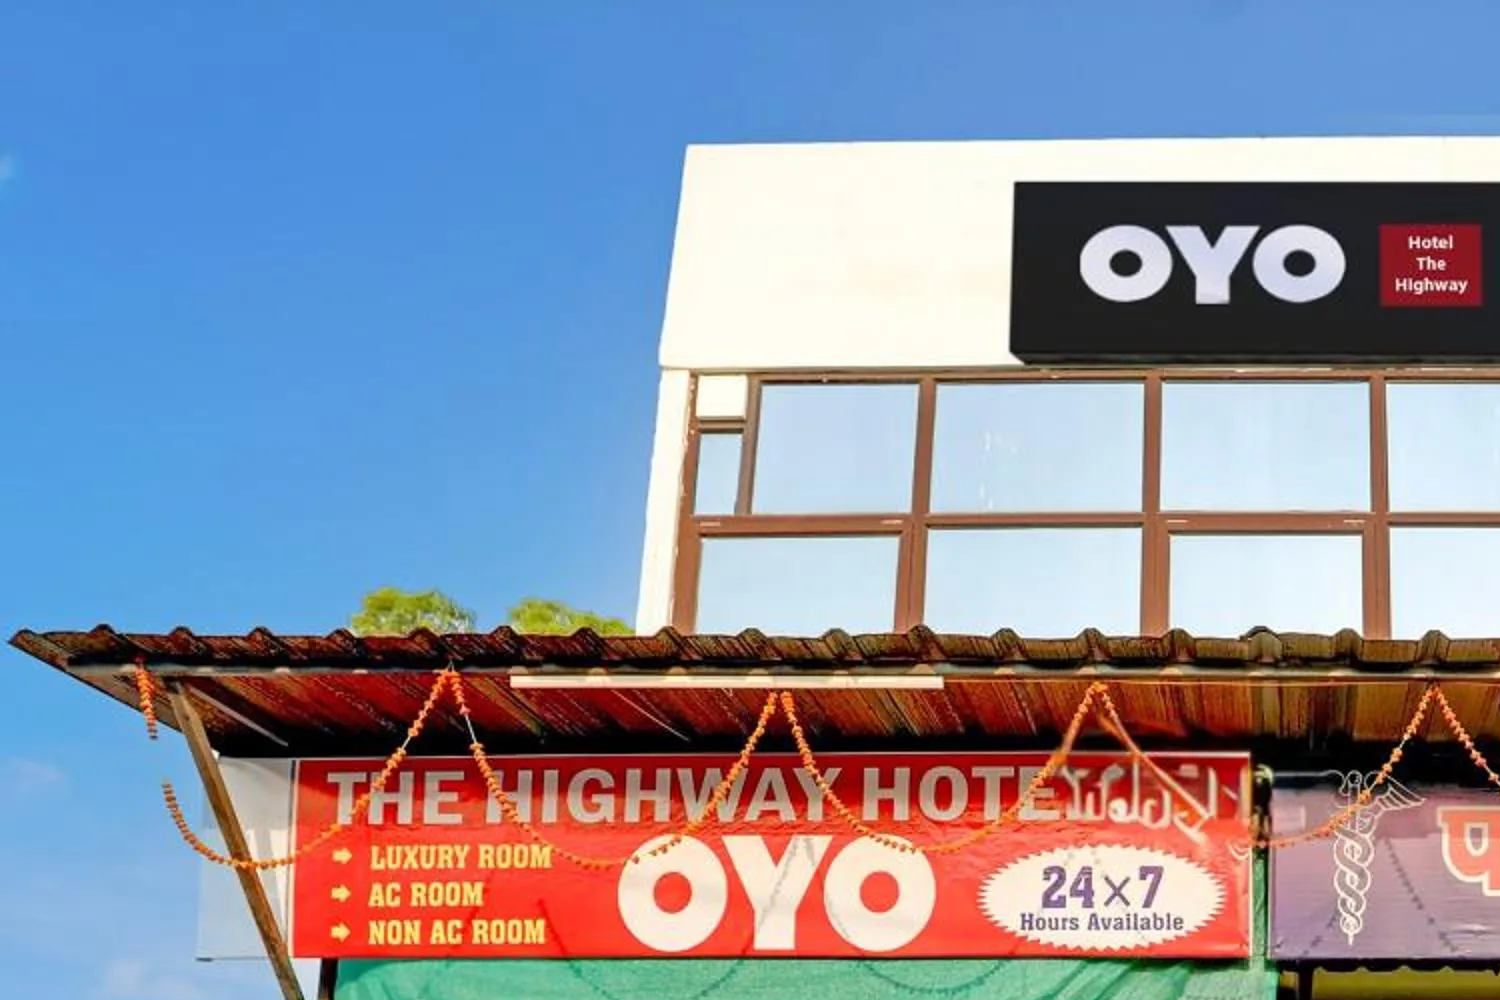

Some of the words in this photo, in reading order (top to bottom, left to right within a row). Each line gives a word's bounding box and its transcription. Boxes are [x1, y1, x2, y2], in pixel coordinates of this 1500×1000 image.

[1408, 234, 1454, 250] Hotel
[1080, 224, 1346, 305] OYO
[1416, 256, 1446, 271] The
[327, 771, 464, 826] THE
[486, 767, 838, 825] HIGHWAY
[370, 845, 469, 870] LUXURY
[478, 844, 553, 870] ROOM
[368, 882, 401, 907] AC
[411, 882, 484, 907] ROOM
[617, 834, 937, 952] OYO
[368, 919, 421, 945] NON
[430, 919, 463, 945] AC
[472, 919, 546, 945] ROOM
[1020, 913, 1080, 931] Hours
[1087, 911, 1184, 931] Available
